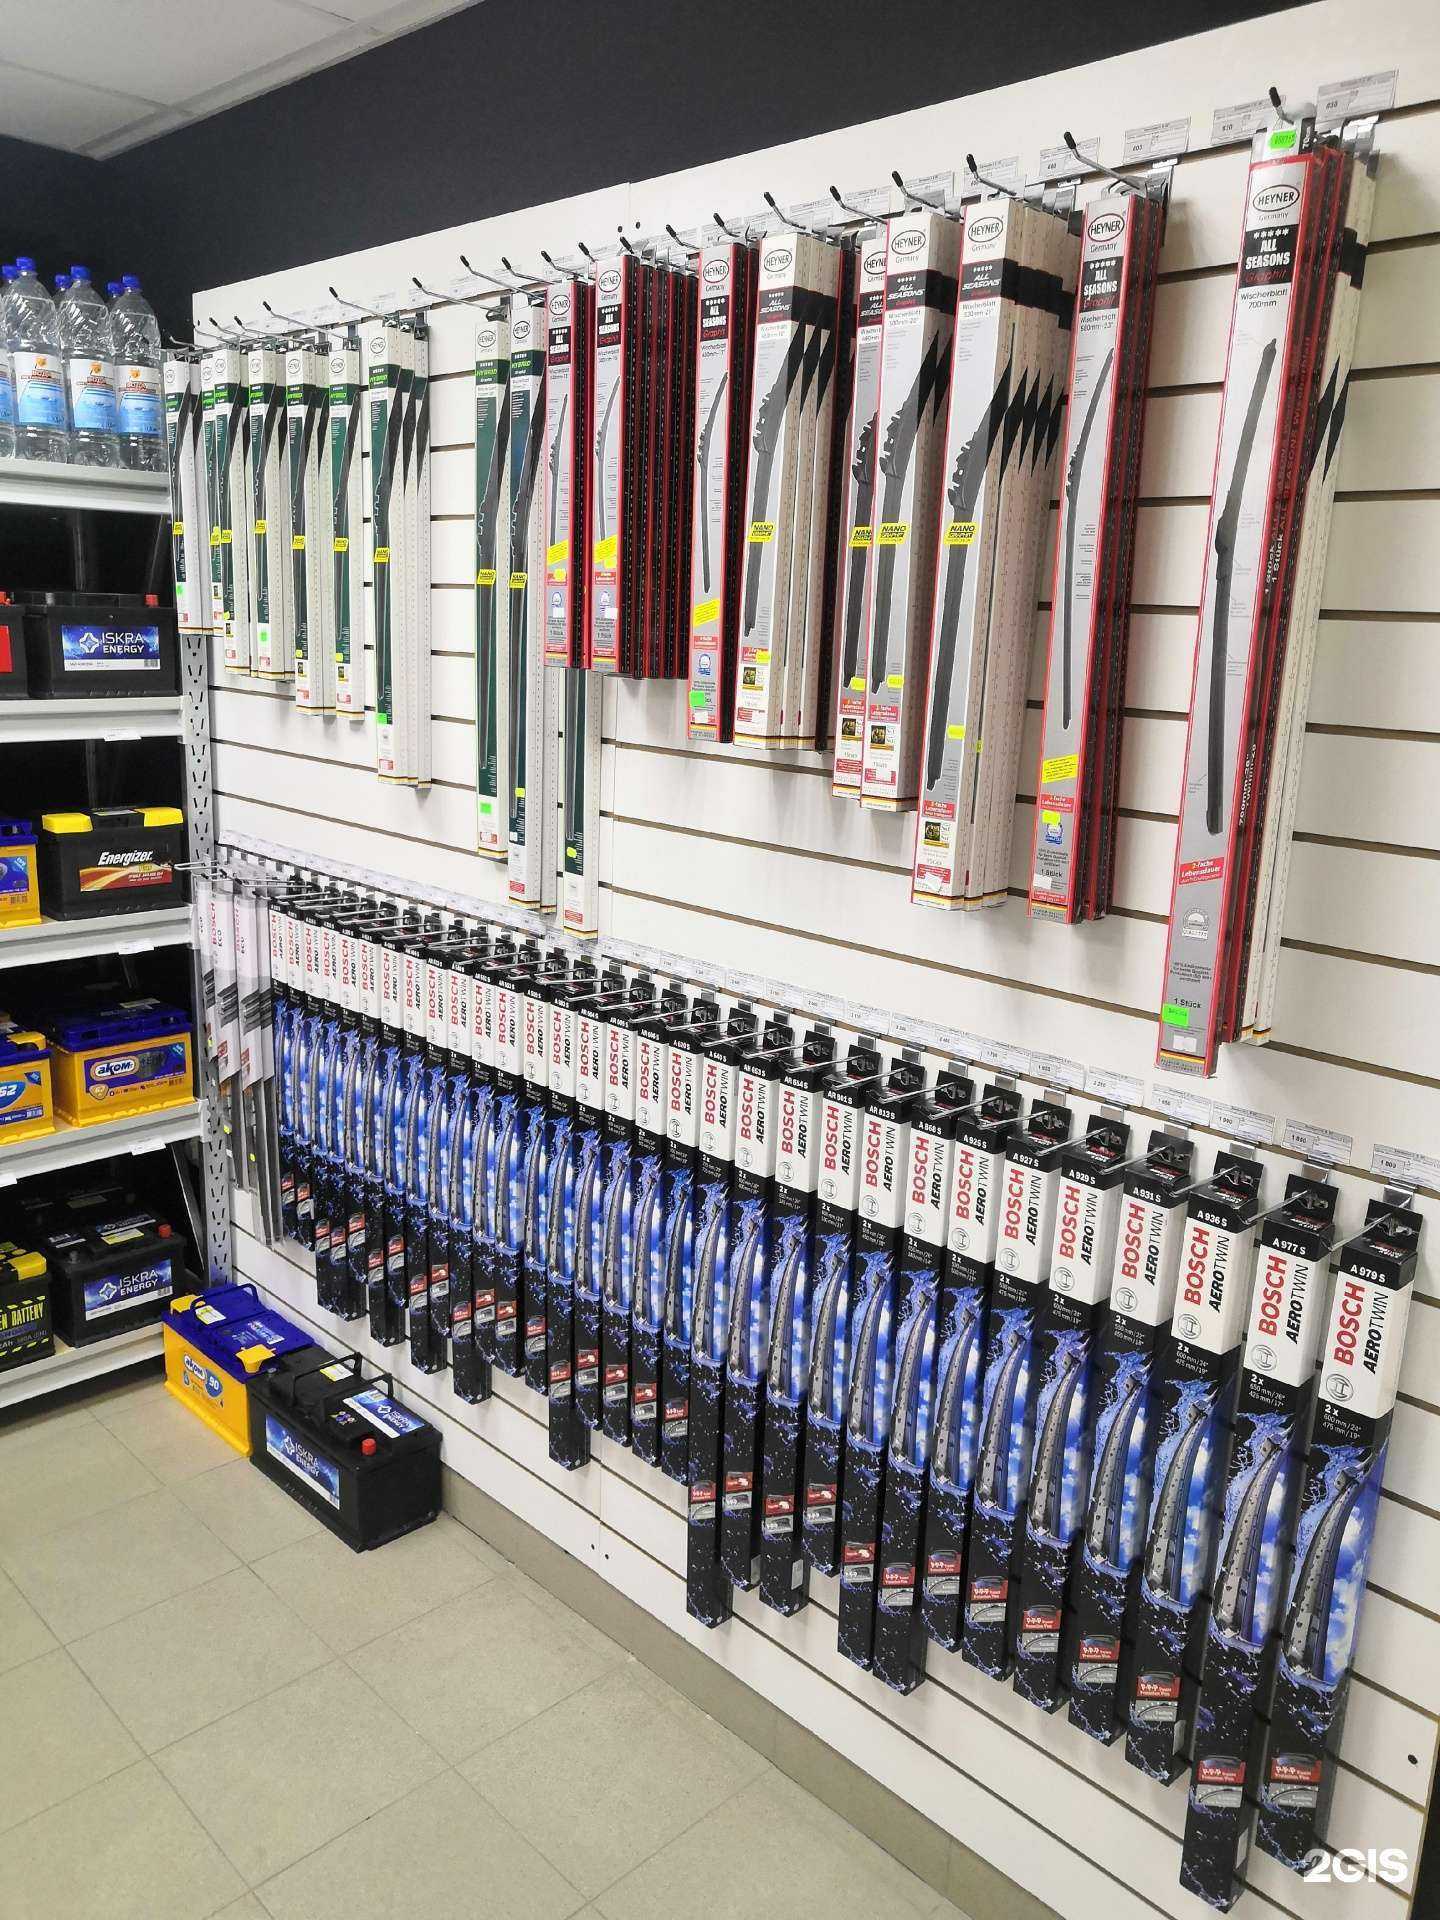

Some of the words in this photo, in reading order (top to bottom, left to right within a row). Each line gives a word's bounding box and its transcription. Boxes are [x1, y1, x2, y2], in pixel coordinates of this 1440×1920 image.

[1258, 191, 1295, 206] HEYNER
[1091, 221, 1121, 235] HEYNER
[1258, 212, 1289, 222] Germany
[971, 223, 1000, 236] HEYNER
[894, 236, 922, 249] HEYNER
[1090, 242, 1117, 253] Germany
[1260, 239, 1278, 253] ALL
[705, 266, 726, 277] HEYNER
[766, 255, 789, 267] HEYNER
[866, 258, 886, 269] HEYN
[1246, 252, 1291, 271] SEASONS
[962, 279, 1001, 291] SEASONS
[974, 274, 990, 282] ALL
[1084, 280, 1118, 294] SEASONS
[1095, 270, 1107, 281] ALL
[888, 288, 925, 300] SEASONS
[898, 284, 914, 292] ALL
[860, 308, 883, 317] SEASO
[102, 633, 144, 644] ISKRA
[103, 645, 145, 655] ENERGY
[98, 850, 153, 866] Energizer
[342, 939, 350, 985] BOSCH
[406, 959, 414, 1009] BOSCH
[428, 970, 436, 1020] BOSCH
[498, 992, 507, 1044] BOSCH
[526, 1002, 535, 1054] BOSCH
[553, 1011, 562, 1065] BOSCH
[580, 1021, 590, 1077] BOSCH
[609, 1030, 619, 1086] BOSCH
[640, 1042, 650, 1100] BOSCH
[652, 1047, 660, 1104] AEROTWIN
[671, 1052, 682, 1112] BOSCH
[684, 1057, 693, 1115] AEROTWIN
[705, 1064, 718, 1125] BOSCH
[828, 1090, 836, 1099] AR
[719, 1069, 729, 1128] AEROTWIN
[741, 1077, 754, 1140] BOSCH
[756, 1083, 767, 1144] AEROTWIN
[782, 1090, 795, 1154] BOSCH
[870, 1105, 878, 1115] AR
[890, 1112, 895, 1120] S
[798, 1096, 809, 1159] AEROTWIN
[918, 1121, 924, 1129] A
[824, 1105, 839, 1171] BOSCH
[841, 1111, 853, 1175] AEROTWIN
[963, 1134, 969, 1142] A
[981, 1141, 987, 1149] S
[865, 1121, 881, 1188] BOSCH
[883, 1126, 896, 1192] AEROTWIN
[1013, 1152, 1019, 1161] A
[1020, 1155, 1033, 1166] 927
[912, 1136, 930, 1205] BOSCH
[930, 1142, 944, 1210] AEROTWIN
[1069, 1170, 1075, 1178] A
[1076, 1172, 1089, 1183] 929
[1089, 1177, 1096, 1185] S
[956, 1150, 974, 1220] BOSCH
[975, 1156, 989, 1226] AEROTWIN
[1132, 1186, 1140, 1195] A
[1140, 1189, 1154, 1200] 931
[1154, 1194, 1161, 1203] S
[1004, 1169, 1025, 1240] BOSCH
[1026, 1175, 1042, 1246] AEROTWIN
[1059, 1185, 1081, 1259] BOSCH
[1080, 1192, 1098, 1266] AEROTWIN
[1197, 1210, 1206, 1219] A
[1205, 1213, 1221, 1225] 936
[1220, 1218, 1228, 1227] S
[1122, 1202, 1146, 1279] BOSCH
[1144, 1211, 1163, 1286] AEROTWIN
[1272, 1238, 1280, 1247] A
[1280, 1240, 1299, 1254] 977
[1299, 1246, 1307, 1255] S
[1184, 1227, 1210, 1306] BOSCH
[1209, 1235, 1229, 1313] AEROTWIN
[1350, 1264, 1359, 1275] A
[1359, 1267, 1378, 1281] 979
[1377, 1273, 1386, 1283] S
[120, 1270, 159, 1288] ISKRA
[120, 1279, 158, 1296] ENERGY
[1258, 1255, 1287, 1336] BOSCH
[1286, 1264, 1309, 1344] AEROTWIN
[12, 1302, 44, 1326] BATTERY
[1334, 1282, 1365, 1366] BOSCH
[1363, 1292, 1389, 1374] AEROTWIN
[208, 1376, 220, 1390] 90
[1250, 1374, 1257, 1382] 2
[1325, 1405, 1332, 1413] 2
[295, 1443, 319, 1466] ISKRA
[296, 1454, 320, 1477] ENERGY
